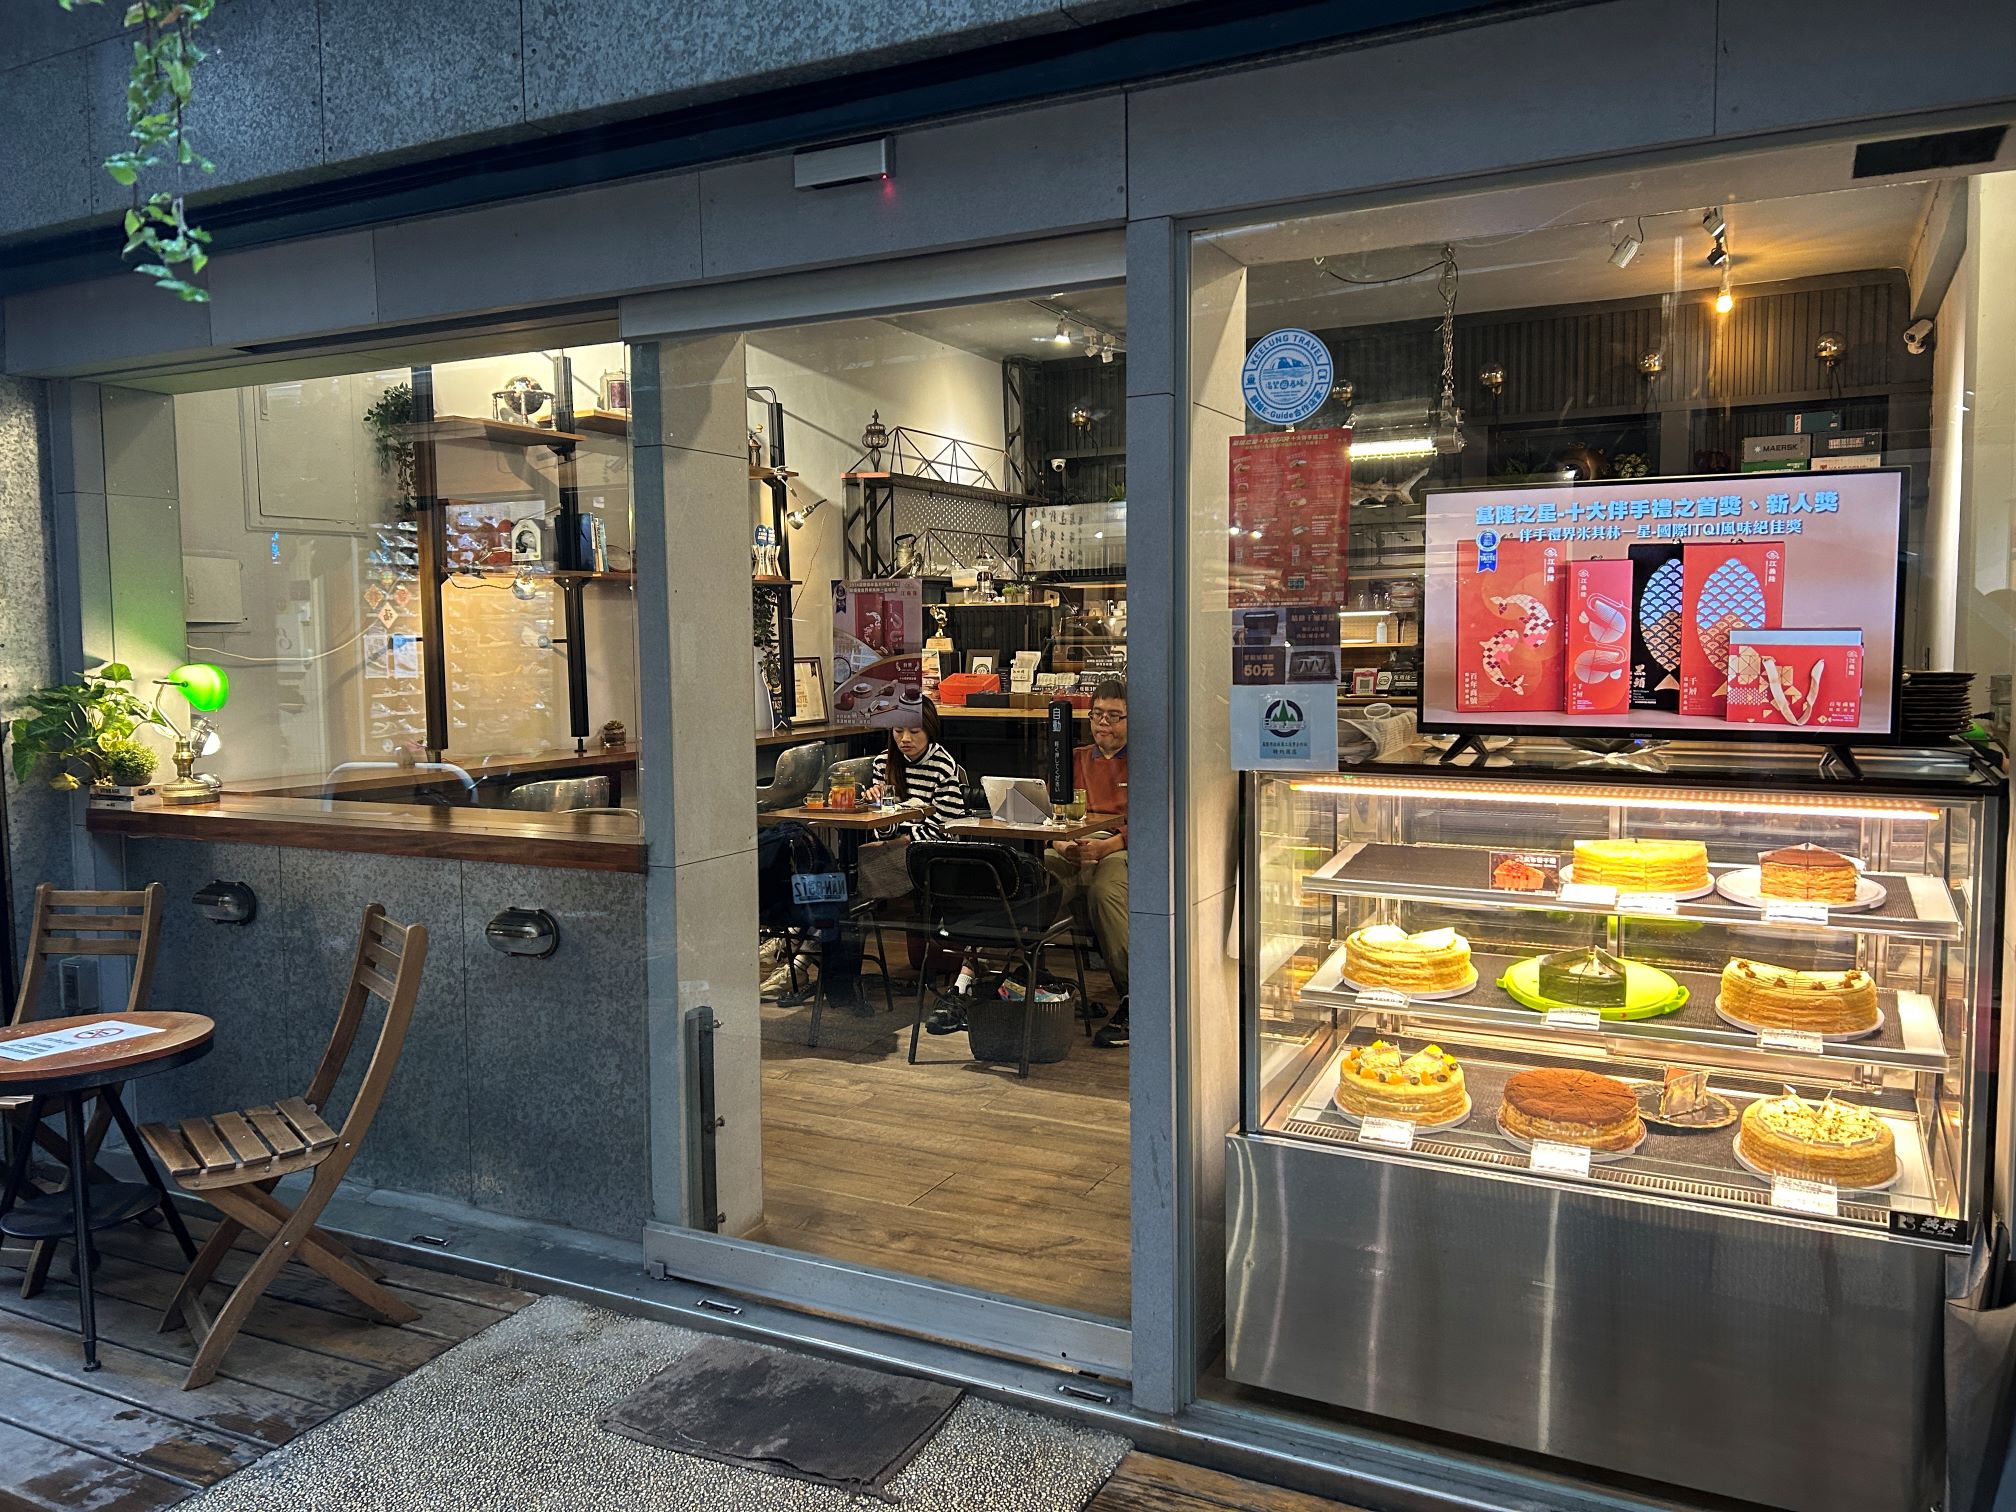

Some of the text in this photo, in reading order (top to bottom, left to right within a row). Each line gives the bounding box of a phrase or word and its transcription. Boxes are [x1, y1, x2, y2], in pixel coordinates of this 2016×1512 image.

[1250, 334, 1323, 366] KEELUNG TRAVEL
[1762, 443, 1798, 452] MAERSK
[1243, 663, 1275, 677] 50元
